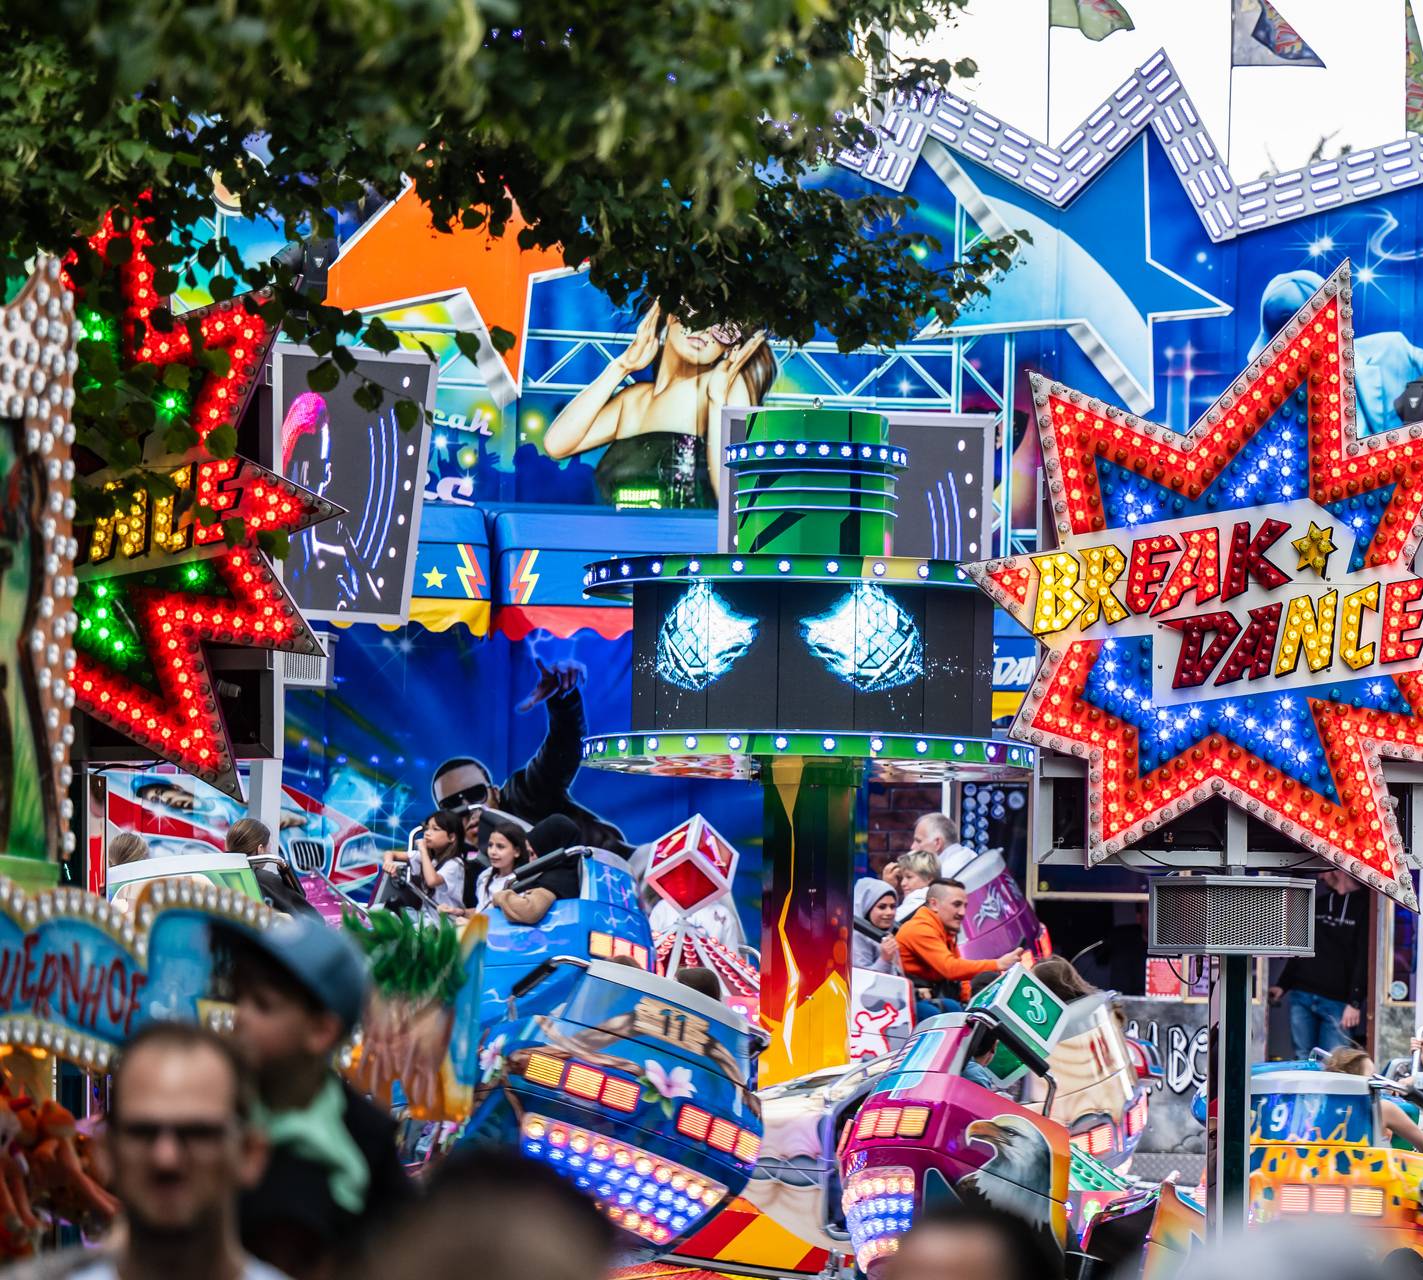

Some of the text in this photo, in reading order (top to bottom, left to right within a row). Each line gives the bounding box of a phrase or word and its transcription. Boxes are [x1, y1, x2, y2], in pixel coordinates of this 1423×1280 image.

[1031, 518, 1292, 636] BREAK
[1022, 986, 1048, 1025] 3
[1270, 1103, 1289, 1132] 9
